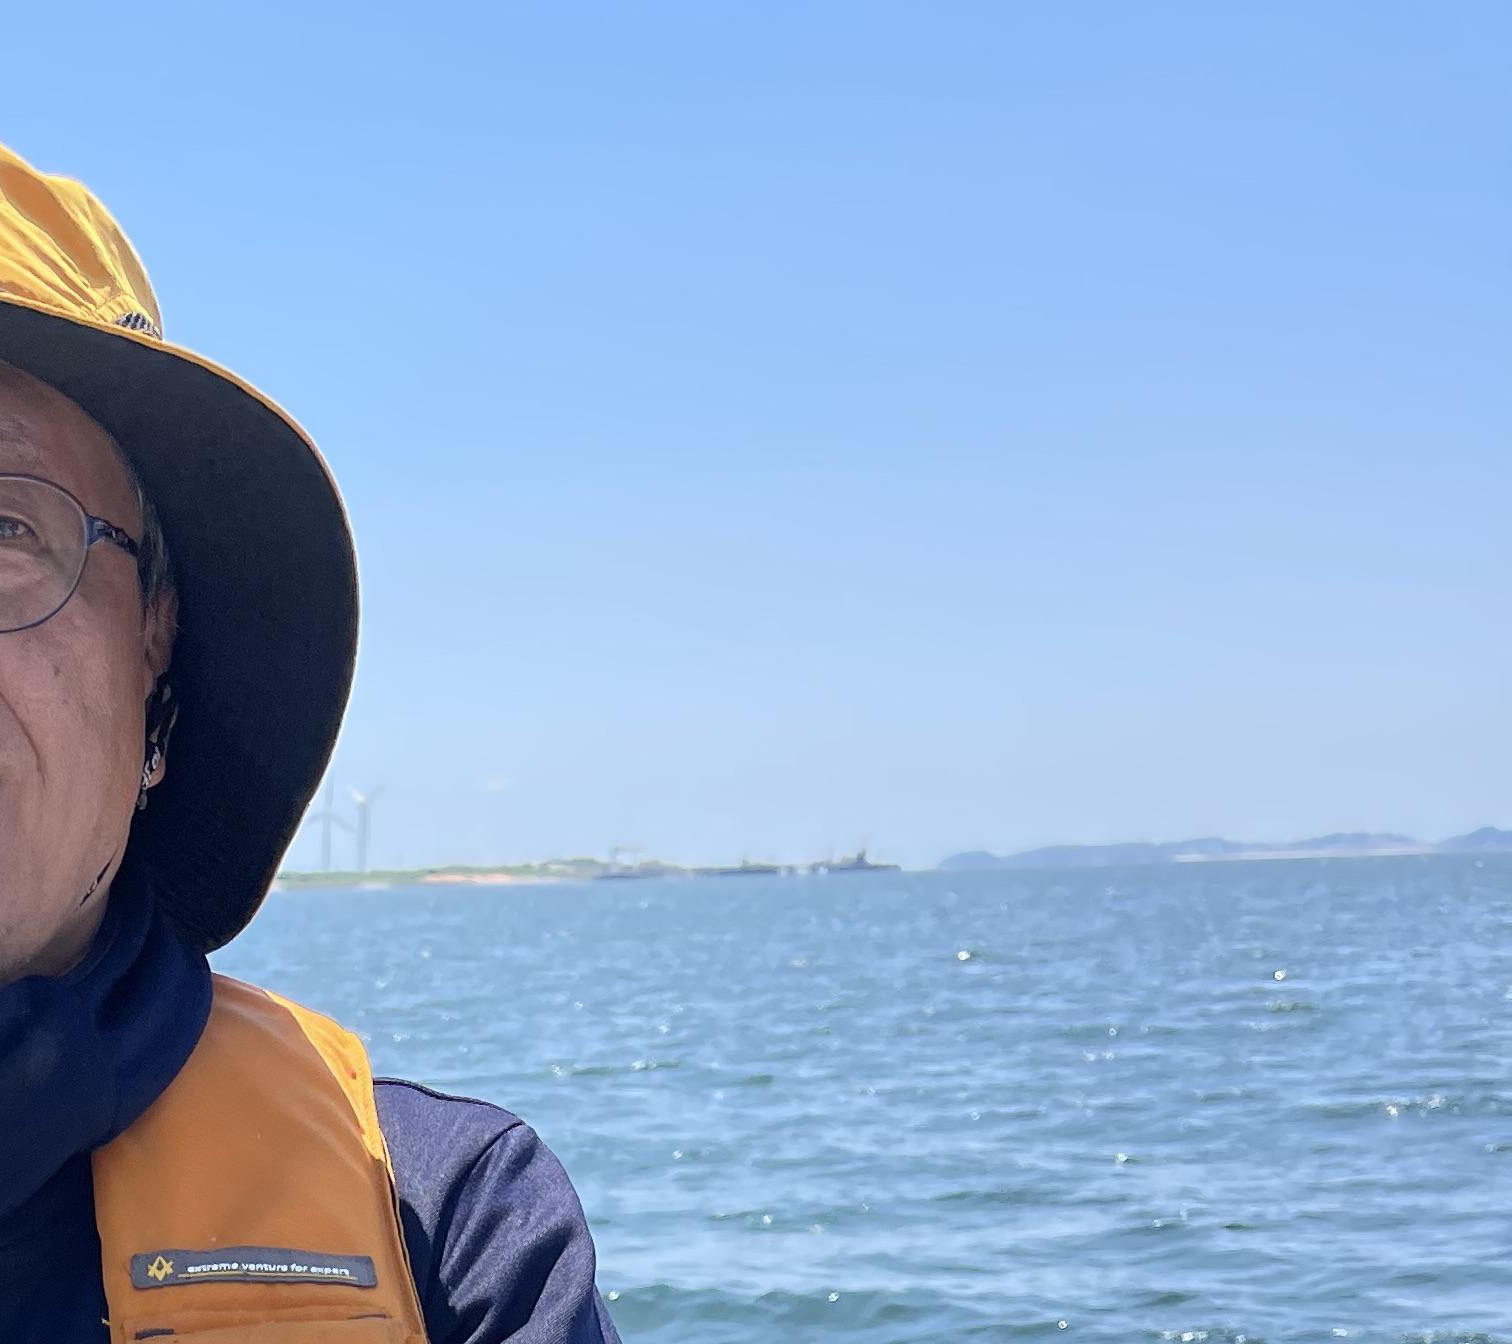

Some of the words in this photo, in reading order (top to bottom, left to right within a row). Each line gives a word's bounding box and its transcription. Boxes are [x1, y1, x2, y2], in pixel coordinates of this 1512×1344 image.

[187, 1261, 238, 1274] extreme
[241, 1262, 289, 1273] venture
[290, 1261, 309, 1274] for
